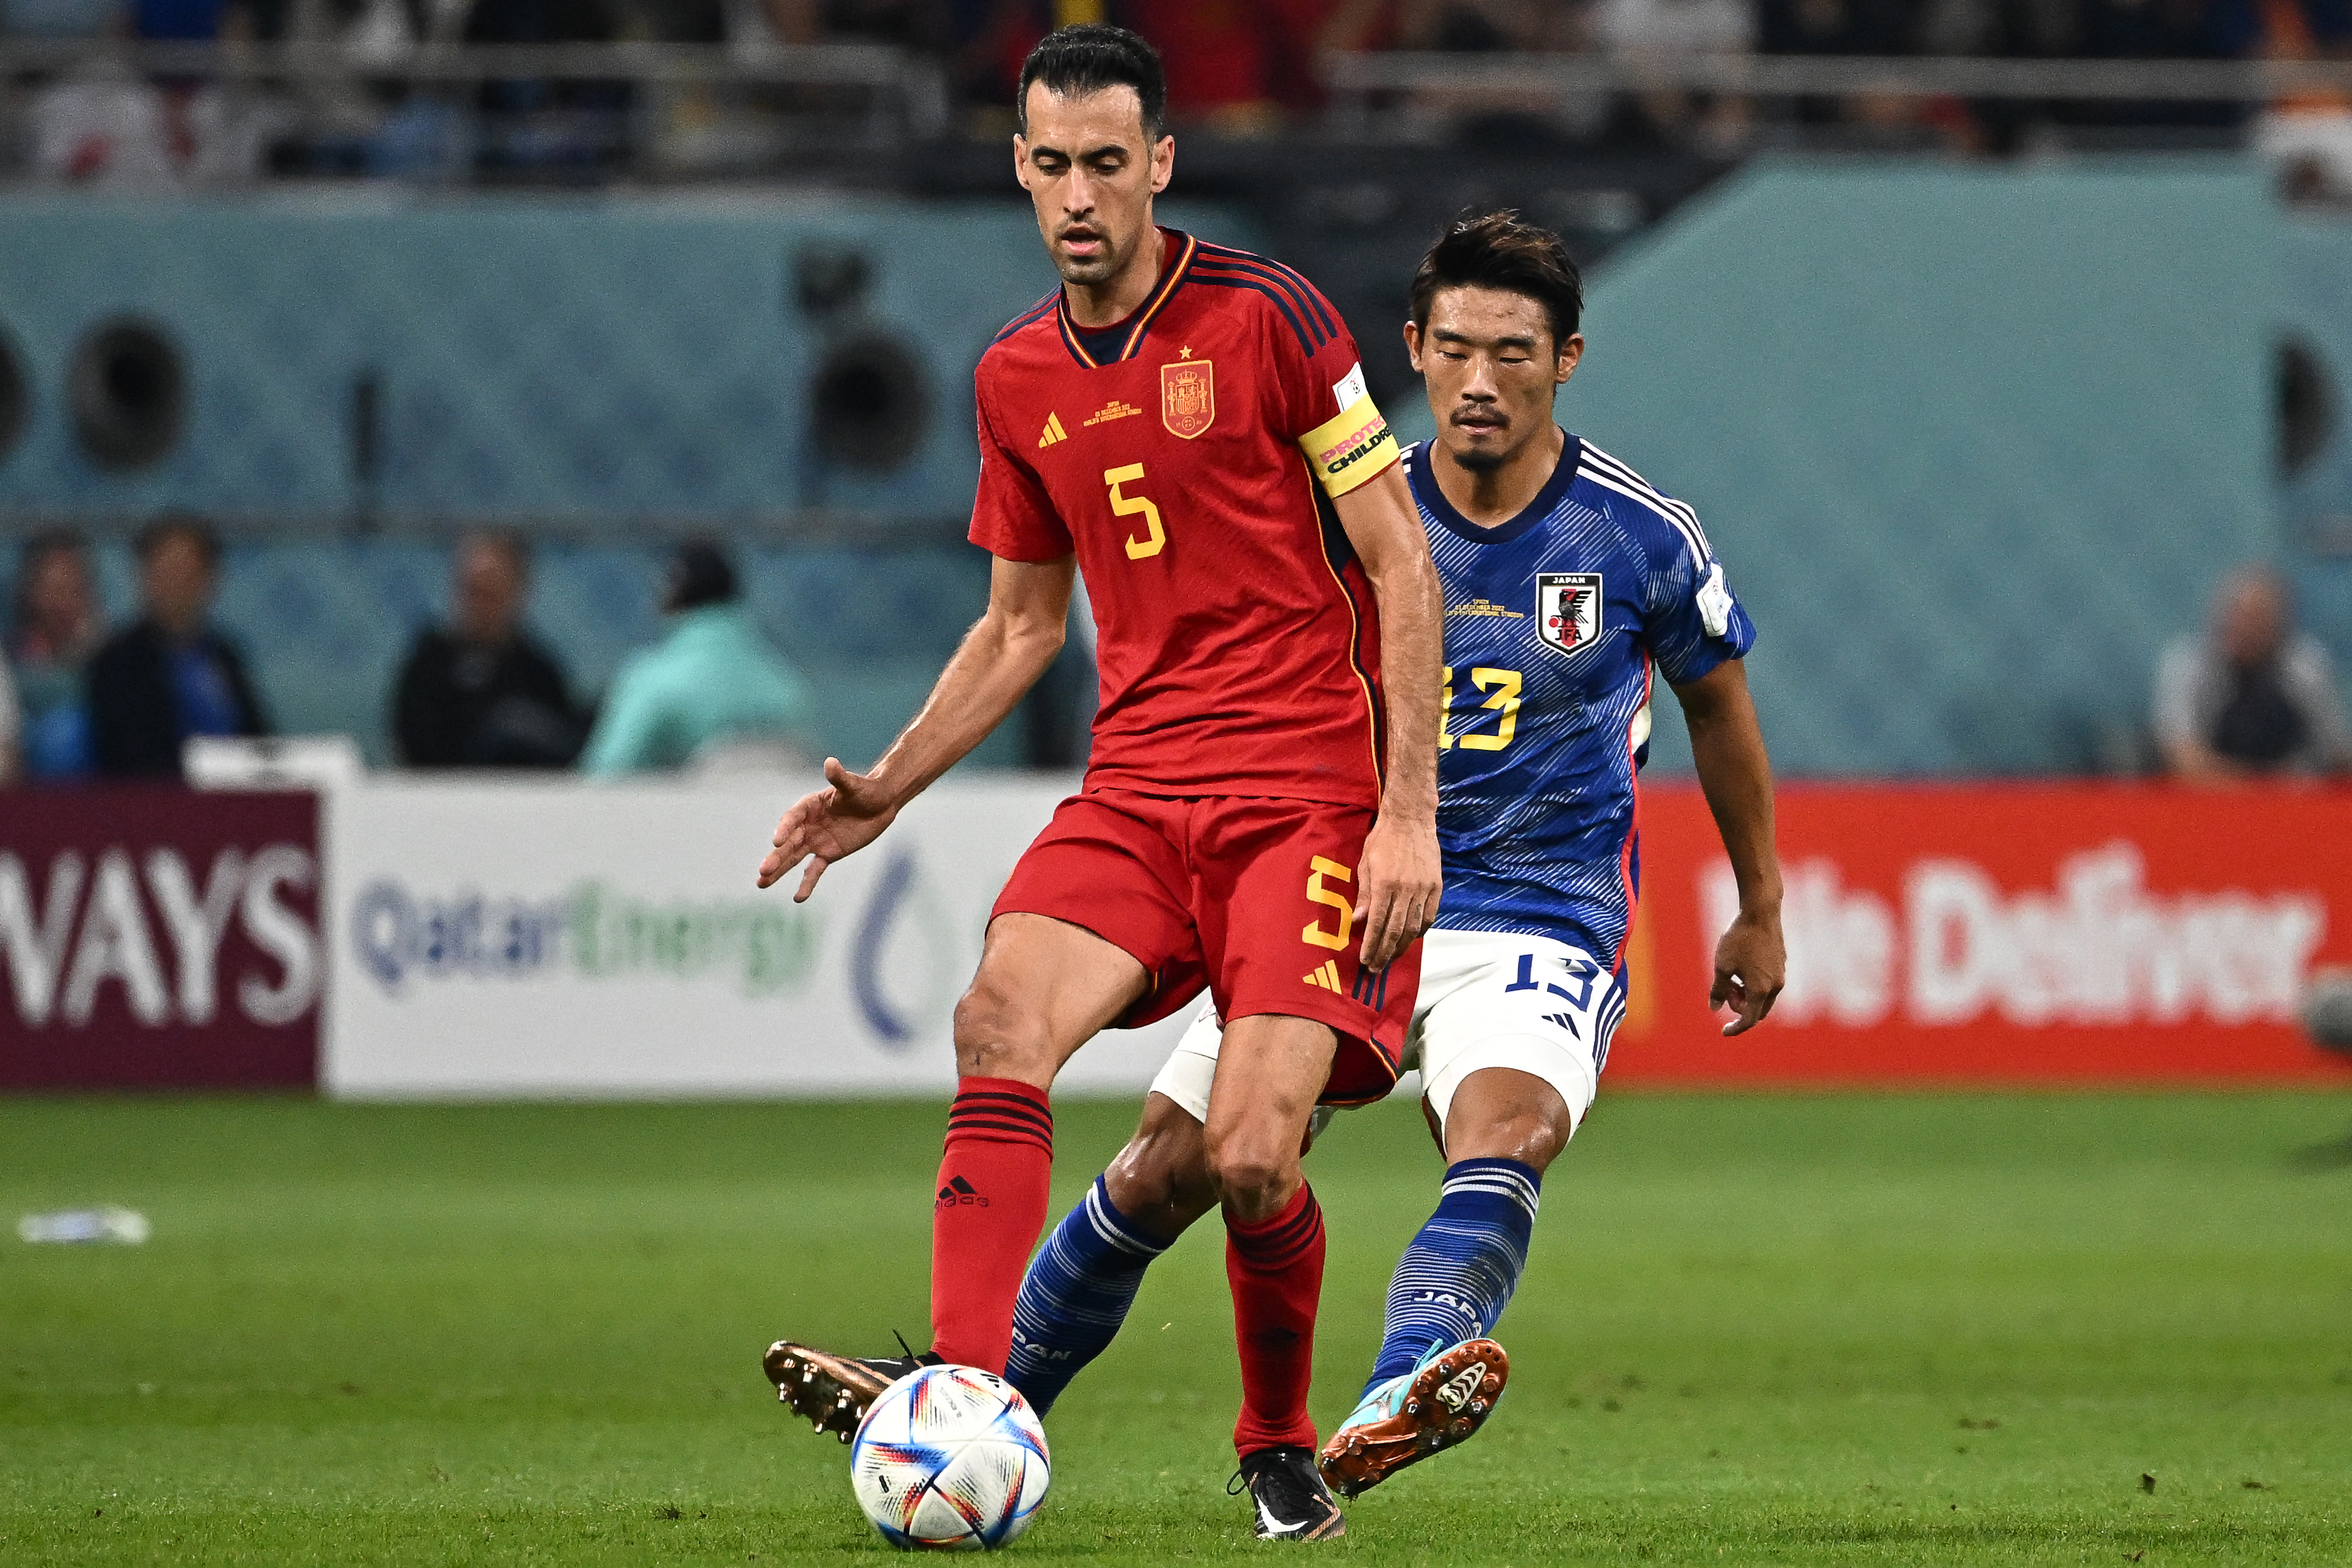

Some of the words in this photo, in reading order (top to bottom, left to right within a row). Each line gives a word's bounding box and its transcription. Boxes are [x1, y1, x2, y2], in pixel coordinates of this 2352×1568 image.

[1320, 414, 1385, 463] PROTEC
[1104, 462, 1165, 559] 5
[1555, 629, 1582, 640] JFA
[1302, 855, 1352, 951] 5
[1908, 841, 2325, 1023] Deliver
[1505, 954, 1600, 1012] 13
